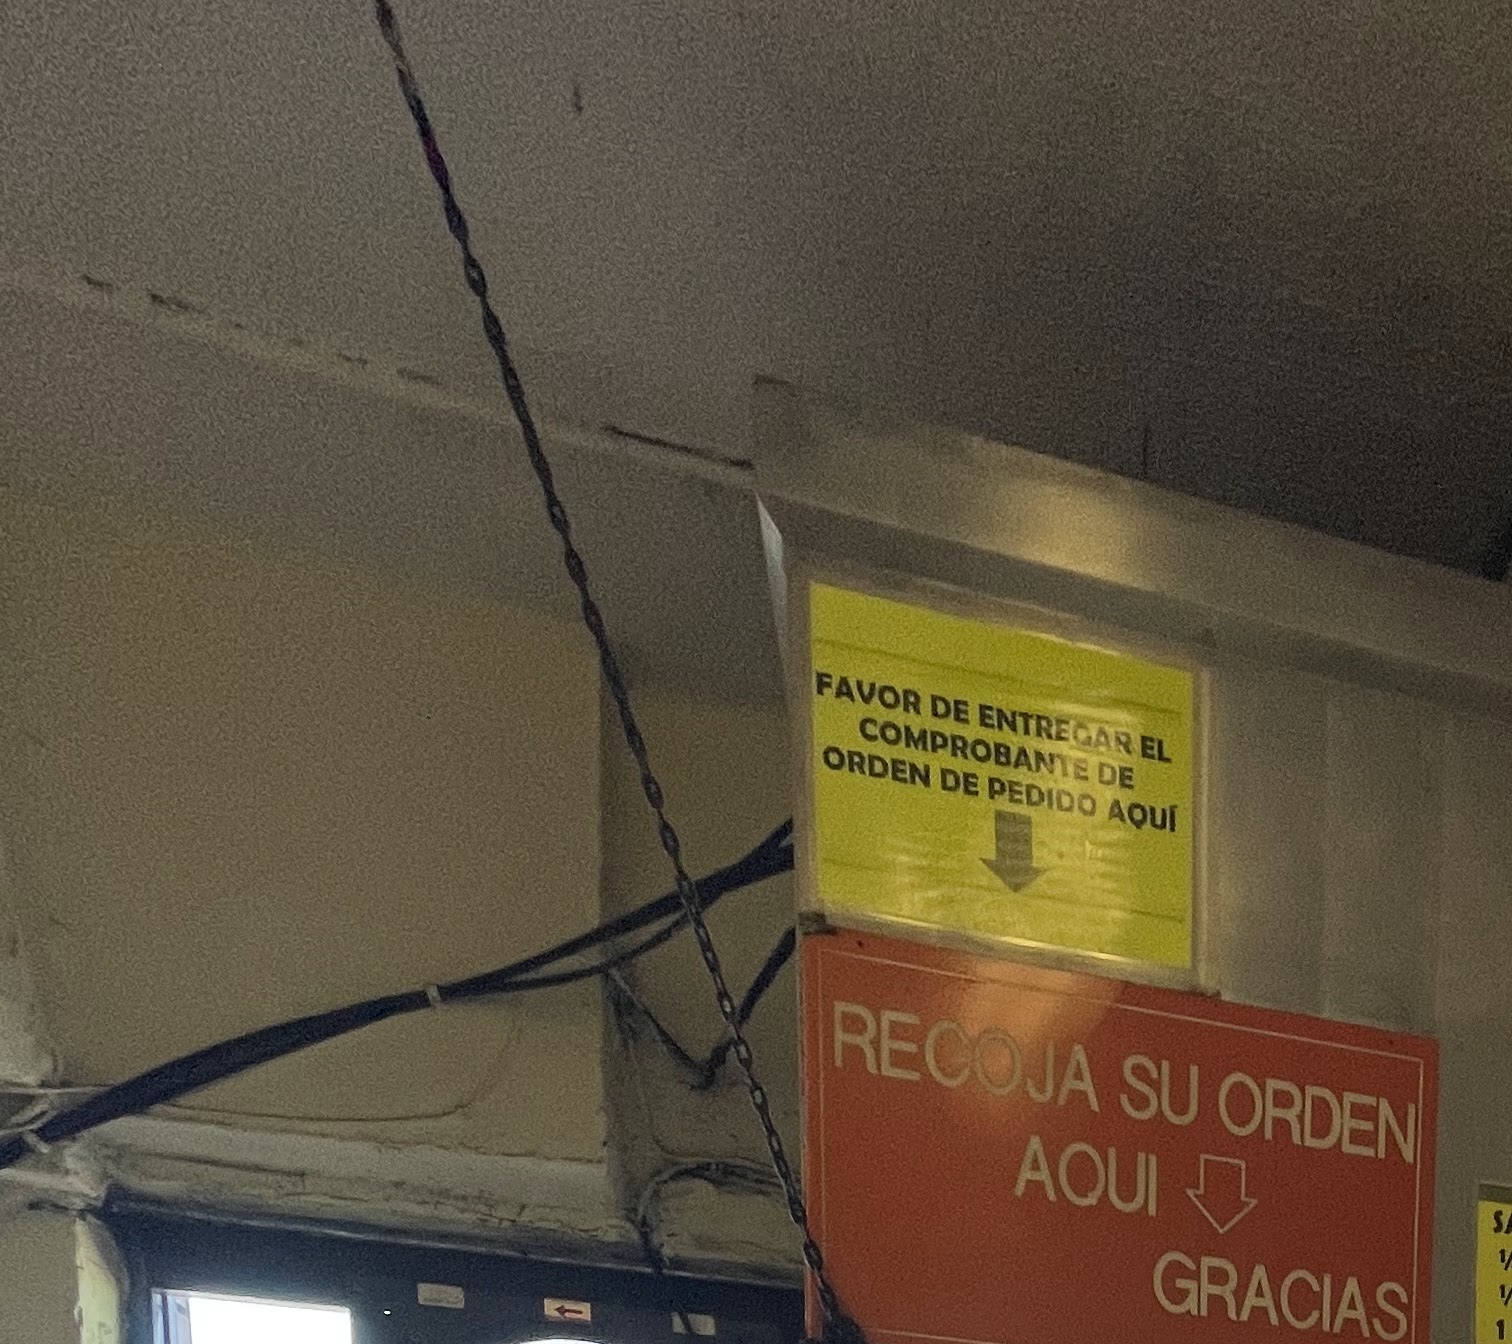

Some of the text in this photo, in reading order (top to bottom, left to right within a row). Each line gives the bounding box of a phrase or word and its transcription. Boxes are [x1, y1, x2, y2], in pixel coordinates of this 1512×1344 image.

[815, 671, 1172, 763] FAVOR DE ENTREGAR EL
[859, 717, 1135, 790] COMPROBANTE DE
[822, 746, 931, 788] ORDEN
[940, 768, 980, 797] DE
[988, 776, 1097, 818] PEDIDO
[833, 1001, 1416, 1165] RECOJA SU ORDEN
[1014, 1133, 1158, 1217] AQUI
[1152, 1250, 1409, 1343] GRACIAS
[1496, 1318, 1505, 1341] 1
